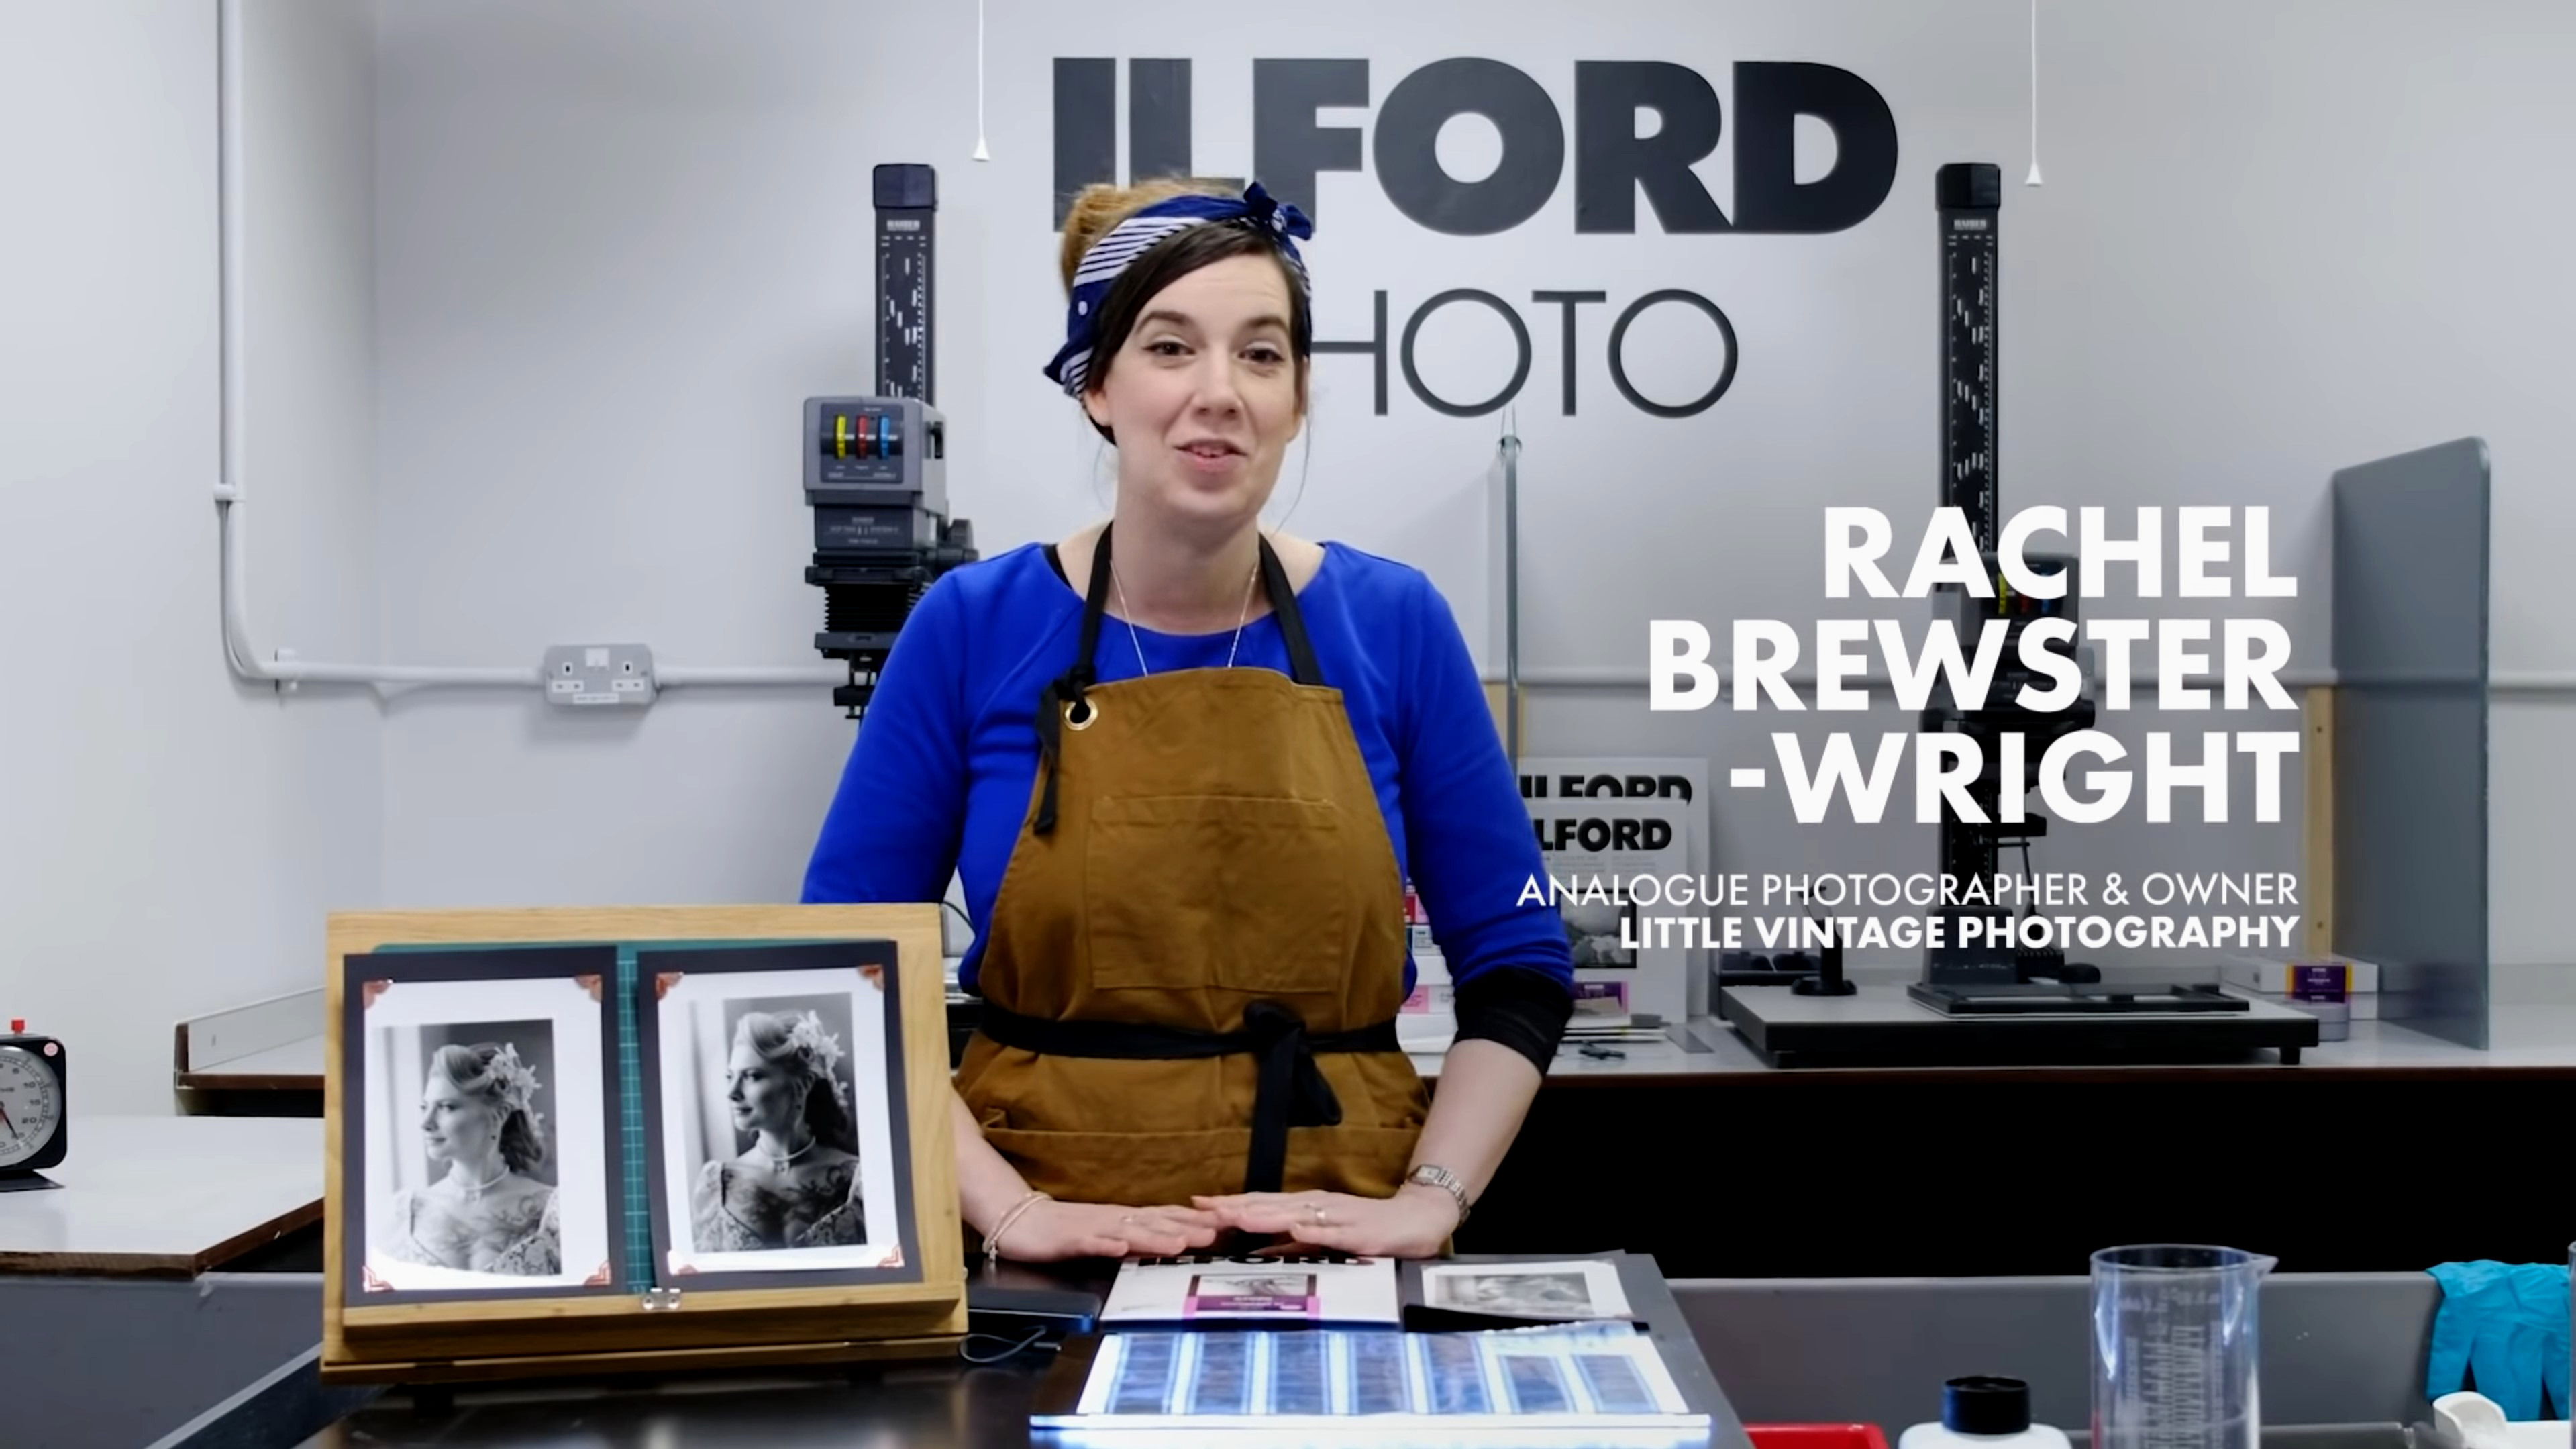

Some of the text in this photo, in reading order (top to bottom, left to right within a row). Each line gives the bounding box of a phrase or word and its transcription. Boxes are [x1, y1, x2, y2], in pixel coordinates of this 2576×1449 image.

[1053, 56, 1898, 237] ILFORD
[1310, 288, 1739, 418] HOTO
[1533, 817, 1672, 852] LFORD
